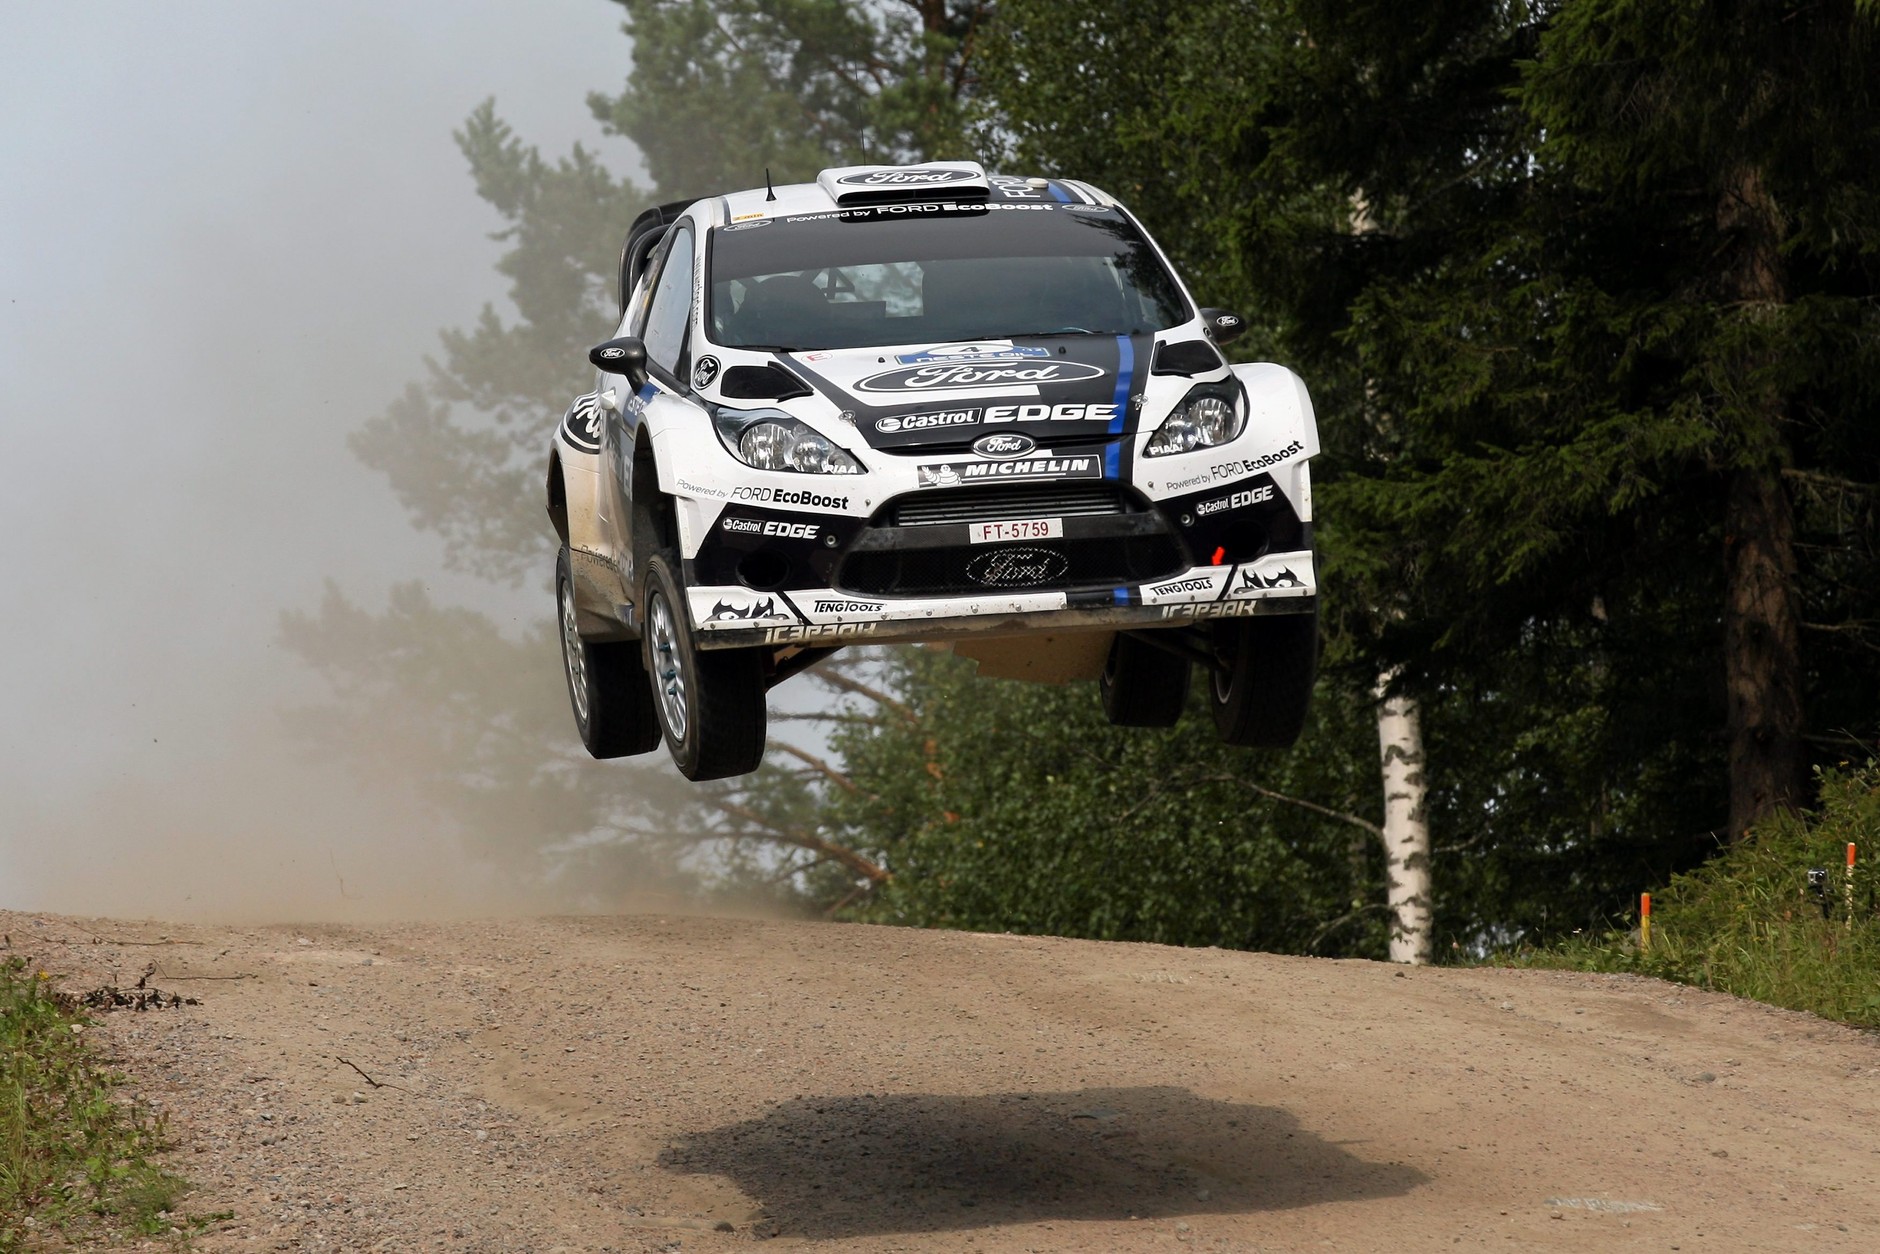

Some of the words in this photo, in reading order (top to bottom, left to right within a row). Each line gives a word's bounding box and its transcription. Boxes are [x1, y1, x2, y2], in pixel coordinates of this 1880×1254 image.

[865, 170, 953, 184] Ford
[786, 211, 850, 223] Powered
[853, 209, 871, 217] by
[876, 204, 939, 214] FORD
[943, 203, 1054, 211] EcoBoost
[904, 361, 1060, 389] Ford
[902, 410, 975, 429] Castrol
[983, 403, 1120, 424] EDGE
[986, 437, 1021, 452] Ford
[964, 459, 1090, 477] MICHELIN
[1166, 474, 1201, 491] Powered
[1201, 472, 1211, 484] by
[1210, 461, 1244, 481] FORD
[1243, 440, 1305, 472] EcoBoost
[676, 478, 716, 496] Powered
[716, 488, 729, 499] by
[730, 486, 772, 501] FORD
[772, 488, 849, 510] EcoBoost
[1205, 497, 1230, 514] Castrol
[1231, 485, 1274, 509] EDGE
[732, 519, 762, 533] Castrol
[763, 521, 820, 540] EDGE
[983, 521, 1049, 540] FT-5759
